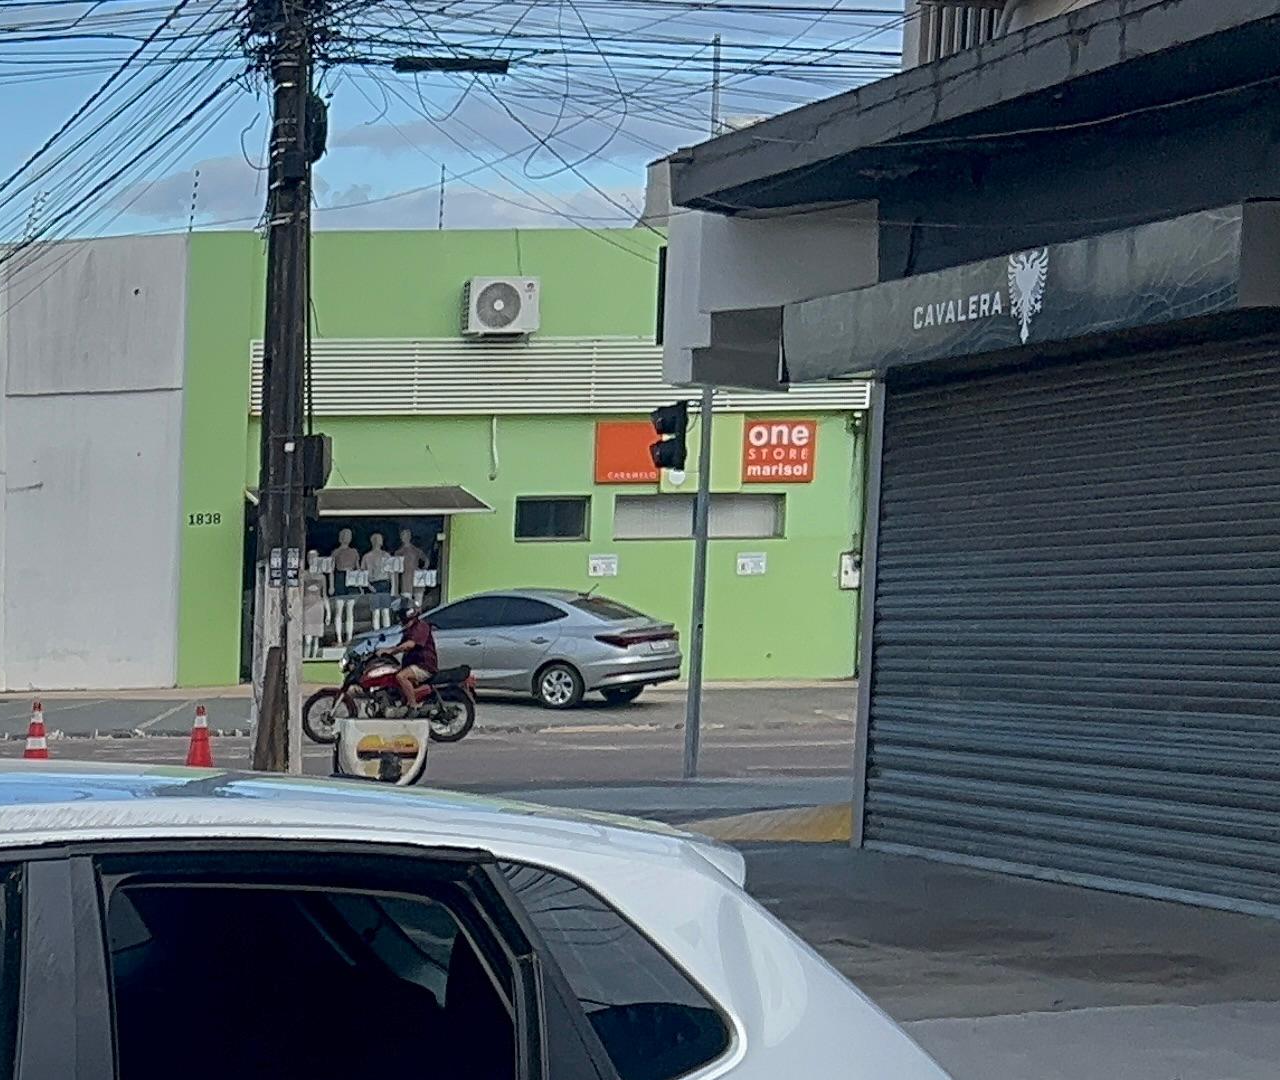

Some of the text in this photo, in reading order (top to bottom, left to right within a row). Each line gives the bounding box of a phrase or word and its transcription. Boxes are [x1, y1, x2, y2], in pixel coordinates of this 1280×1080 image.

[913, 291, 1002, 330] CAVALERA
[748, 424, 809, 447] one
[748, 447, 809, 461] STORE
[747, 462, 809, 477] marisol
[188, 512, 221, 526] 1838
